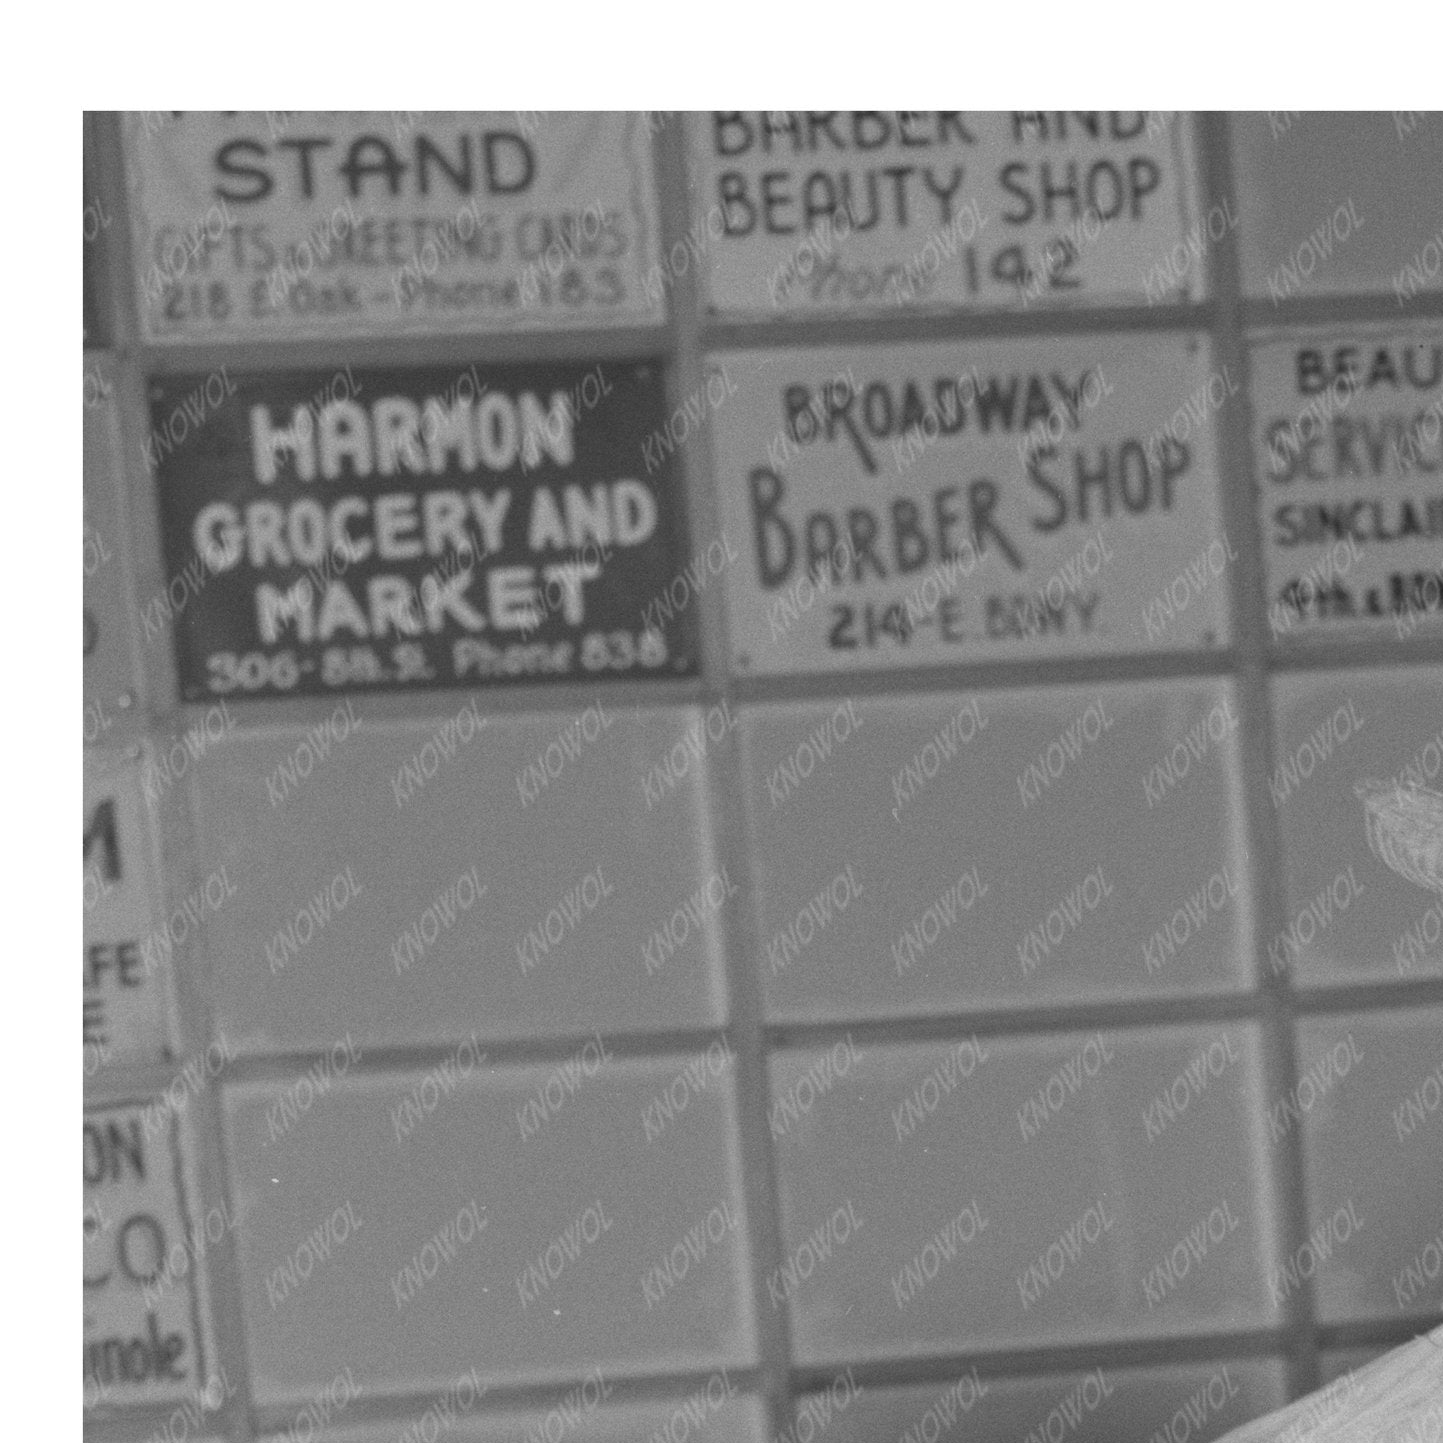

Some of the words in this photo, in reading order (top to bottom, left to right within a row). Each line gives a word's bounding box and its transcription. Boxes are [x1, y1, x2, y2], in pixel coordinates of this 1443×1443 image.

[214, 130, 537, 203] STAND
[713, 113, 975, 157] BARBER
[718, 163, 965, 239] BEAUTY
[998, 157, 1162, 226] SHOP
[152, 222, 277, 277] GIFTS
[775, 249, 938, 300] Phone
[964, 238, 1085, 295] 142
[249, 391, 575, 485] HARMON
[783, 370, 1094, 475] BROADWAY
[193, 489, 511, 571] GROCERY
[527, 478, 660, 551] AND
[749, 466, 1026, 592] BARBER
[1029, 436, 1193, 535] SHOP
[255, 561, 602, 645] MARKET
[453, 636, 574, 679] Phone
[580, 628, 668, 673] 838
